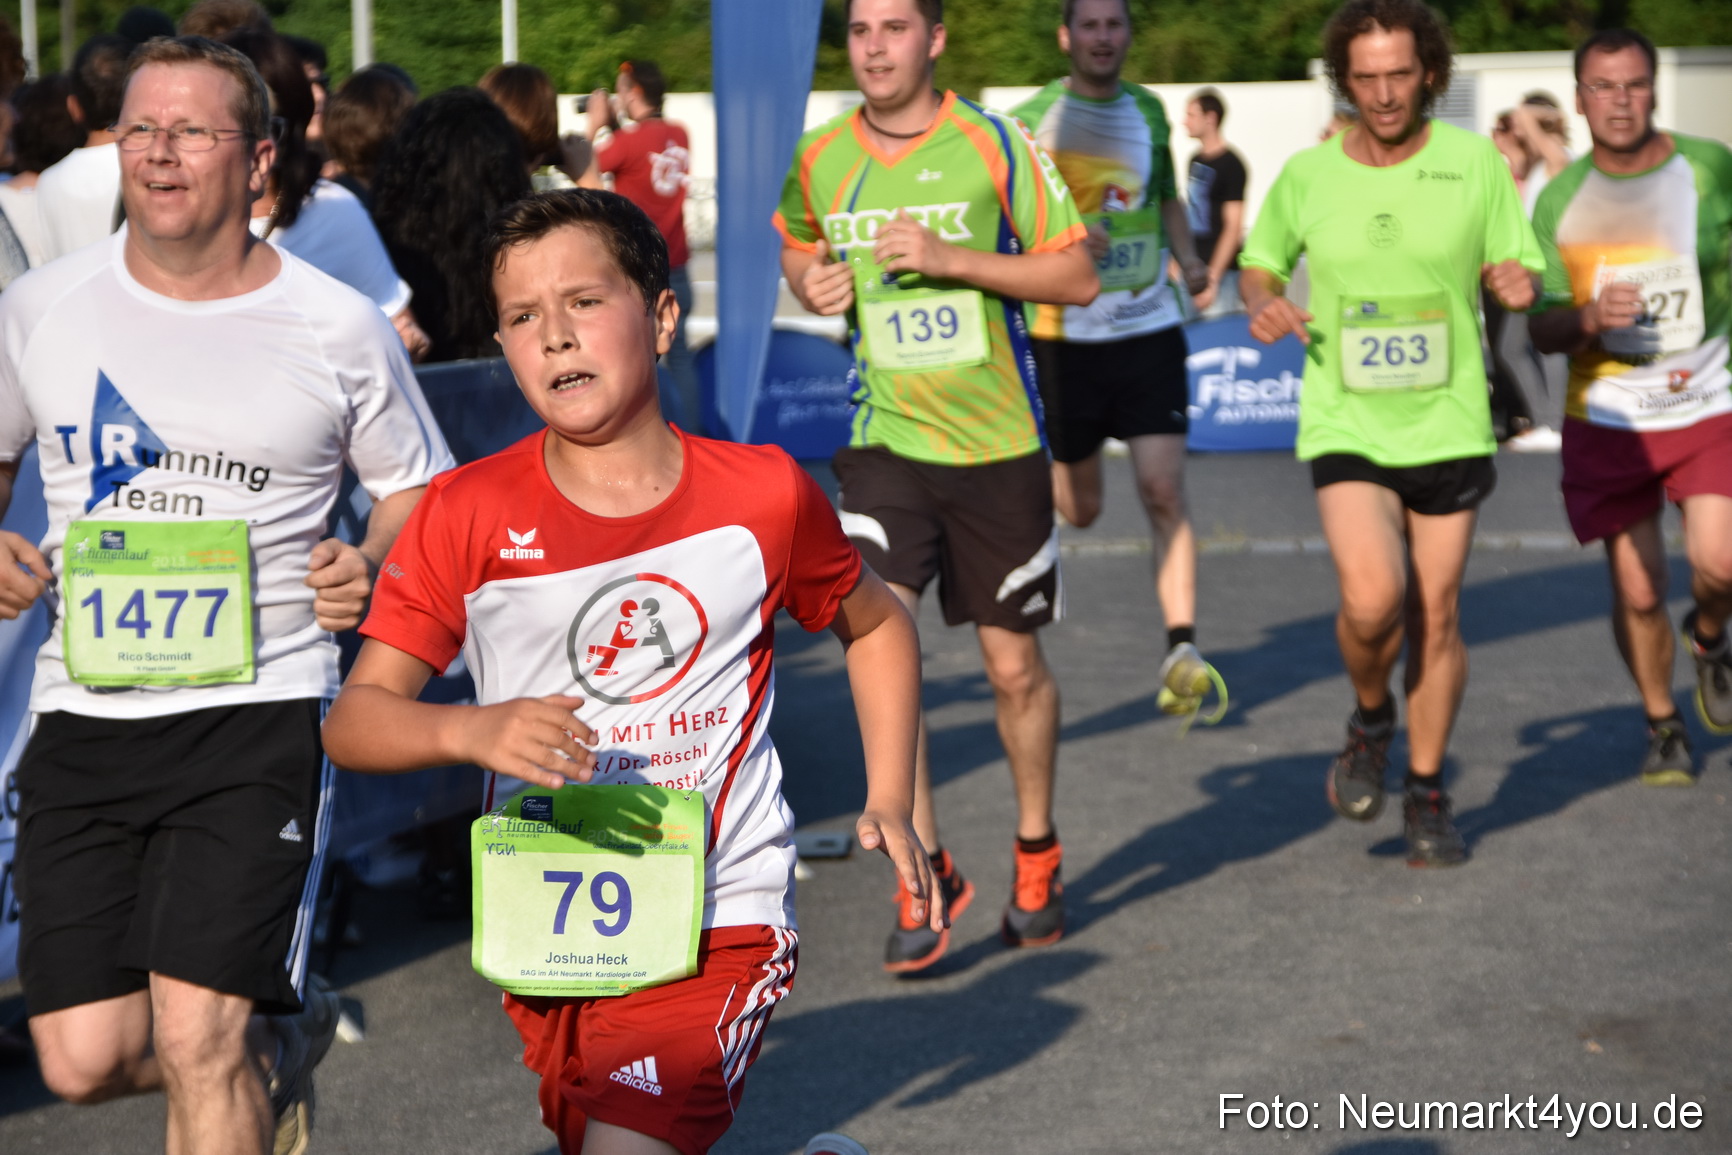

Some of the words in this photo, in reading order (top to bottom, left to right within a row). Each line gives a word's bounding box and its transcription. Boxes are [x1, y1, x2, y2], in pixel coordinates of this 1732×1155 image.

[1637, 289, 1689, 323] 27
[886, 304, 959, 344] 139
[1359, 333, 1430, 367] 263
[1197, 369, 1304, 408] Fisch
[110, 480, 204, 517] Team
[87, 548, 149, 562] firmenlauf
[499, 546, 544, 560] erima
[385, 562, 405, 580] für
[80, 587, 230, 640] 1477
[117, 651, 143, 662] Rico
[144, 651, 193, 662] Schmidt
[611, 723, 656, 744] MIT
[618, 757, 645, 771] Dr.
[650, 742, 709, 768] Röschl
[506, 819, 584, 835] firmenlauf
[542, 870, 633, 937] 79
[545, 952, 594, 964] Joshua
[597, 953, 629, 965] Heck
[595, 971, 631, 979] Kardiologie
[609, 1071, 663, 1096] adidas
